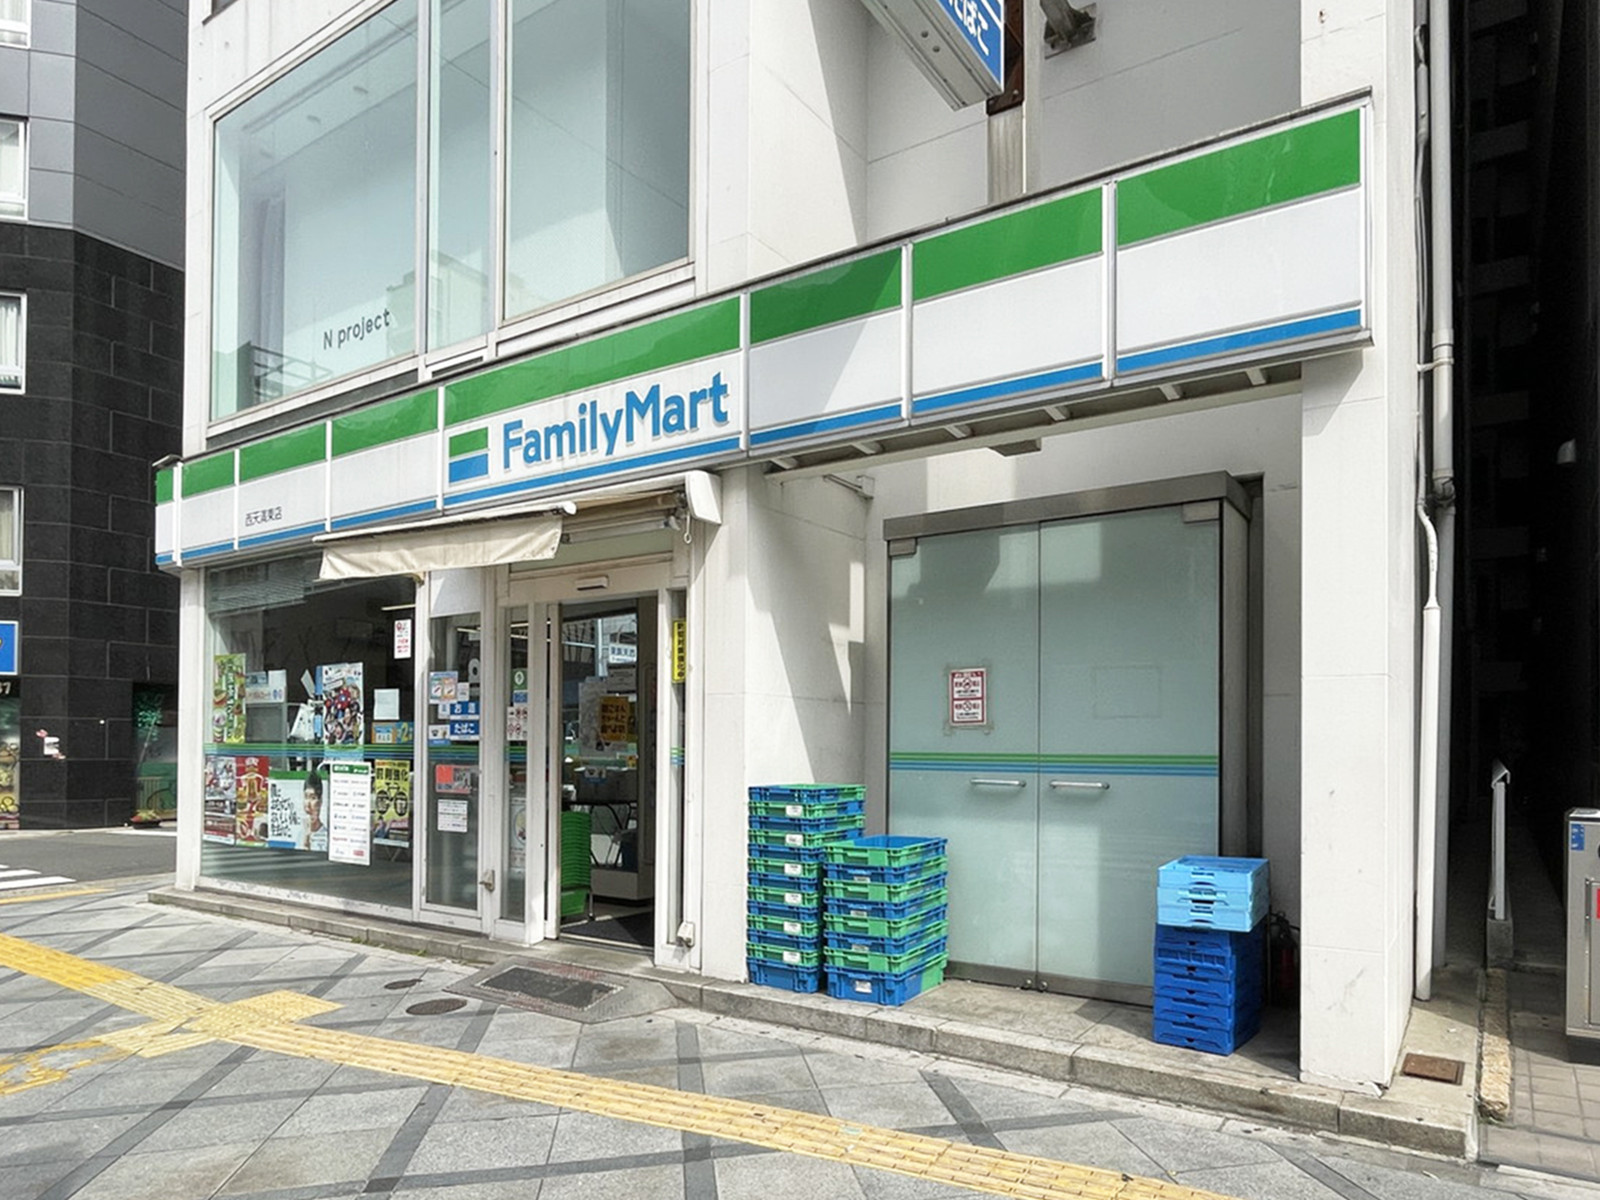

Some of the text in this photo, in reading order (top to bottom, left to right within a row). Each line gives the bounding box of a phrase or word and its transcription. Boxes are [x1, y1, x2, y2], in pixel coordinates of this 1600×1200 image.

[323, 308, 390, 350] N project
[503, 371, 729, 470] FamilyMart
[453, 721, 476, 735] たばこ
